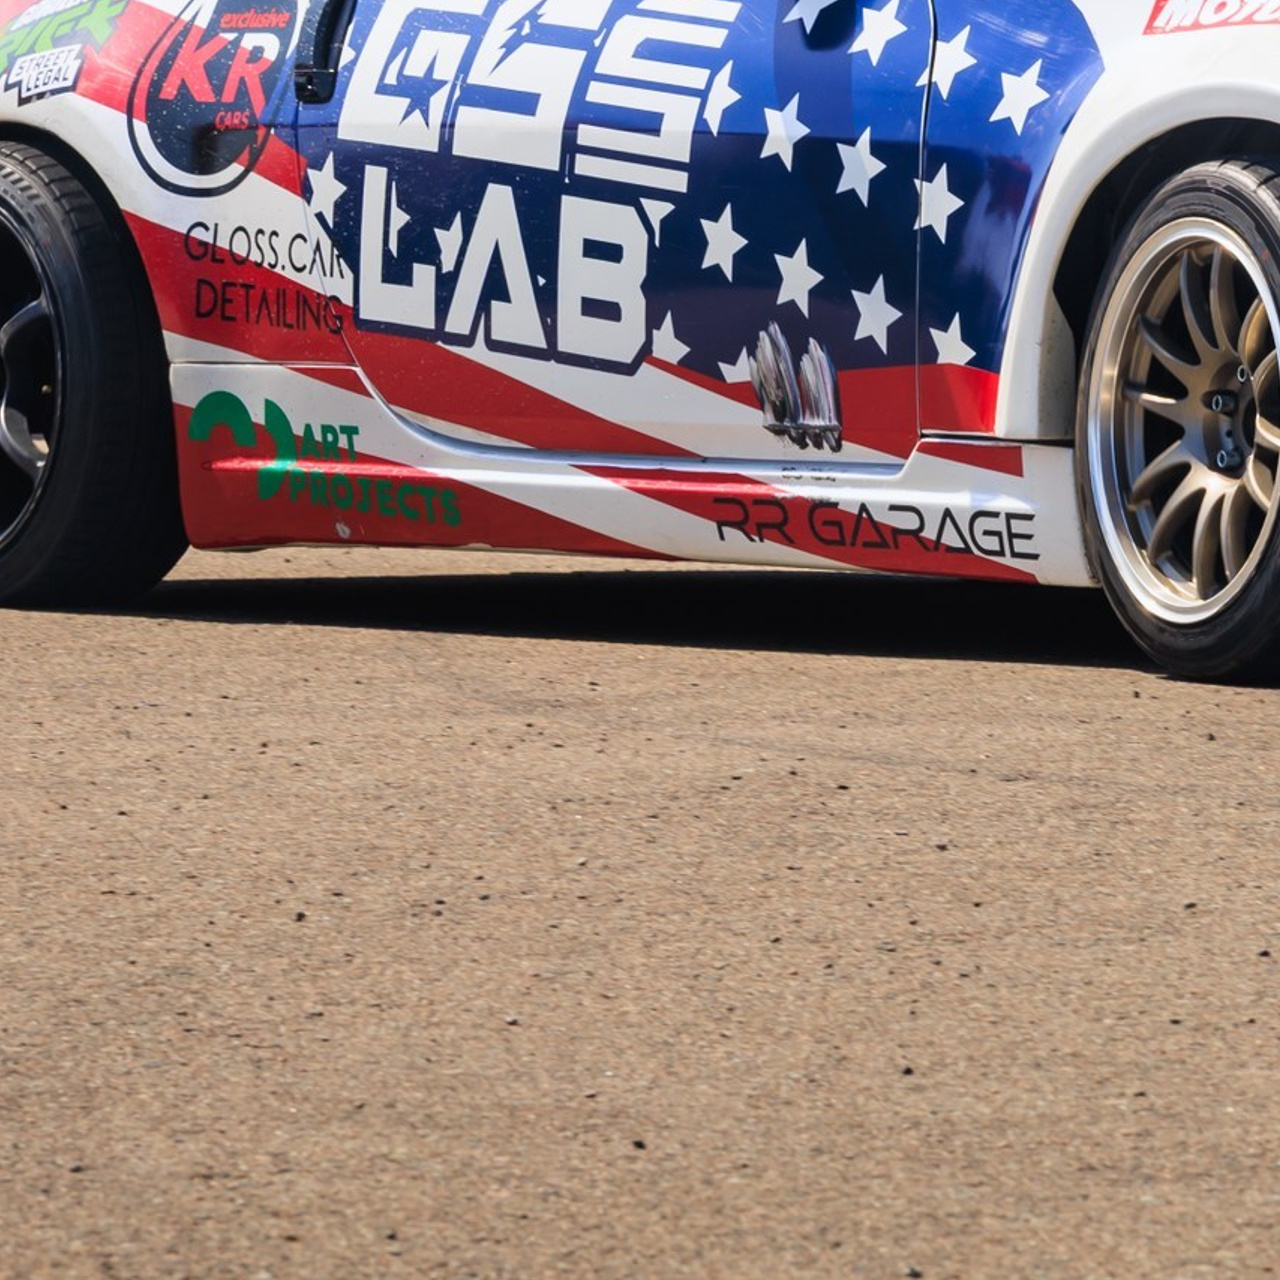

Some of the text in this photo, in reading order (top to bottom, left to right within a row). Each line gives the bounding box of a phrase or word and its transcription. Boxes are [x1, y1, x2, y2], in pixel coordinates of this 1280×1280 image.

[219, 8, 291, 29] exclusive
[26, 65, 70, 92] LEGAL
[158, 32, 280, 118] KR
[214, 110, 250, 131] CARS
[359, 165, 648, 366] LAB
[195, 277, 343, 334] DETAILING
[295, 423, 360, 461] ART
[290, 470, 461, 526] PROJECTS
[713, 497, 1041, 560] RR GARAGE
